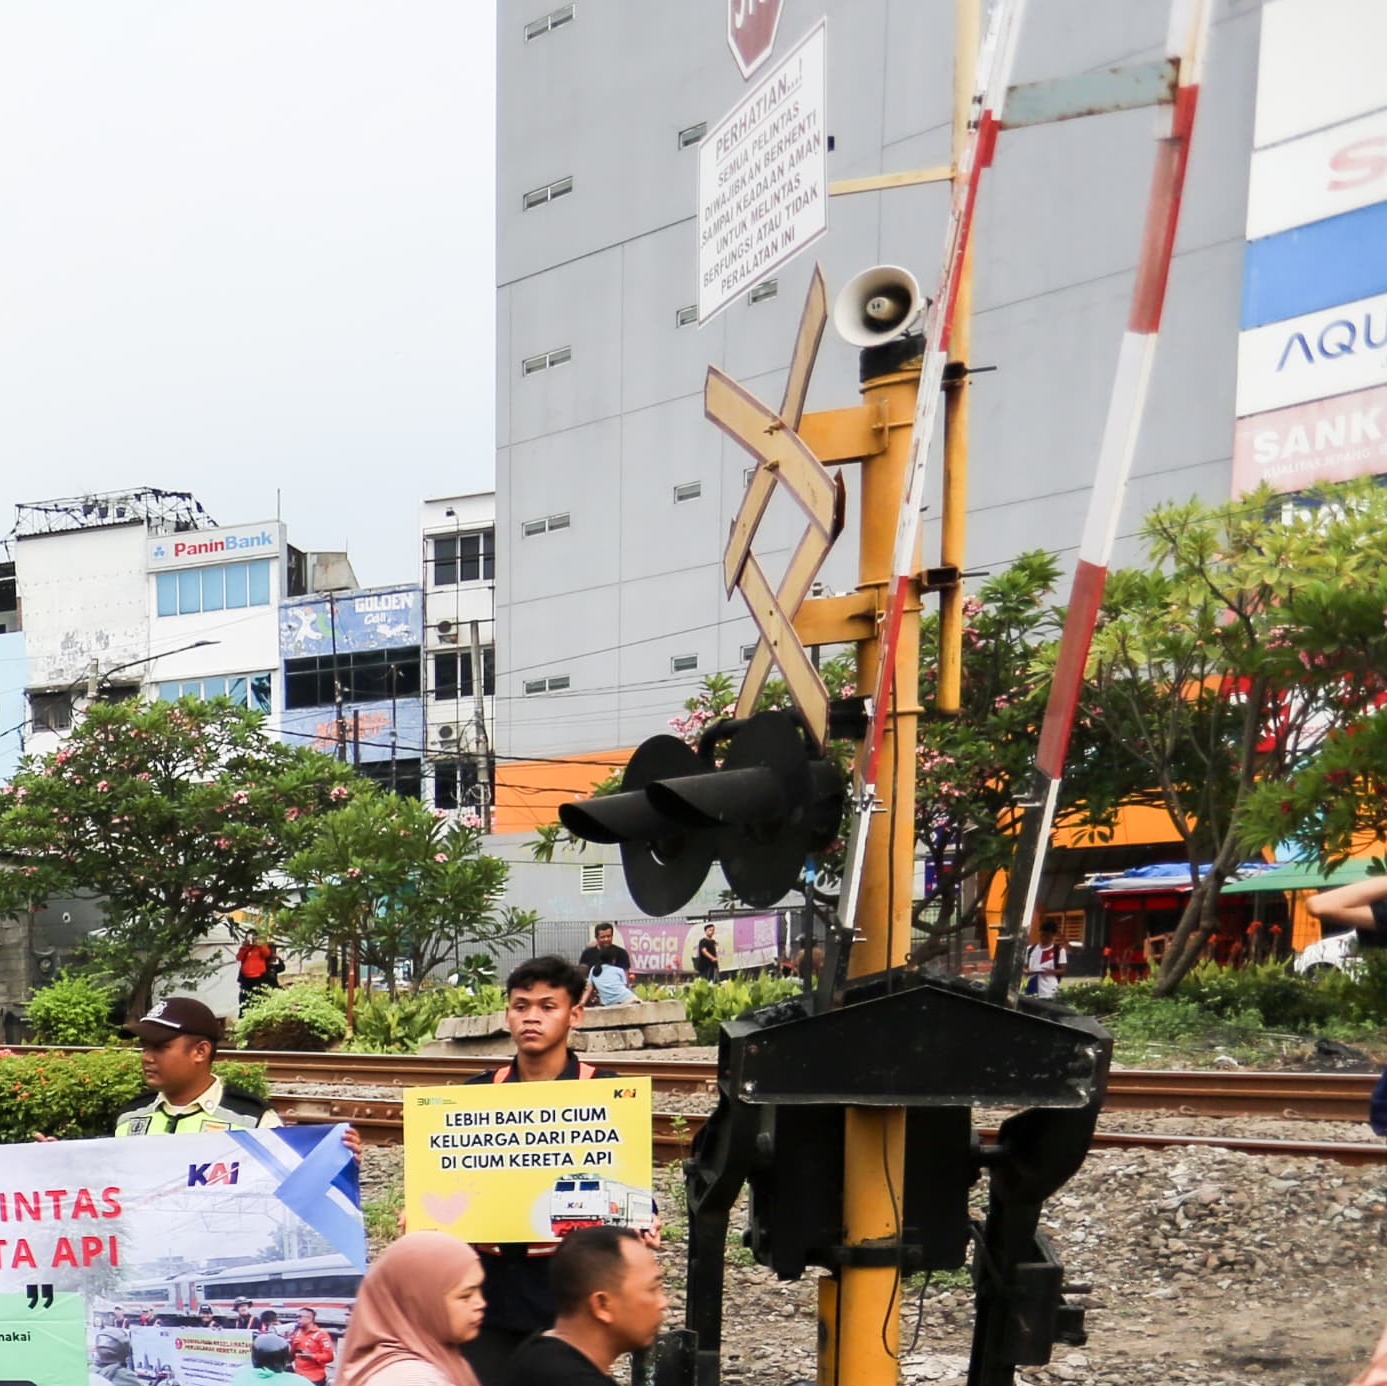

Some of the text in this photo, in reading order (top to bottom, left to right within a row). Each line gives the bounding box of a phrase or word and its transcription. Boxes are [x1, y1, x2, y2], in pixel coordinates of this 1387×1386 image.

[705, 109, 816, 222] DIWAJIBKAN BERHENTI
[718, 101, 799, 187] SEMUA PELINTAS
[702, 131, 821, 246] SAMPAI KEADAAN AMAN
[717, 173, 801, 255] UNTUK MELINTAS
[704, 183, 818, 287] BERFUNGSI ATAU TIDAK
[721, 225, 795, 294] PERALATAN INI
[174, 531, 273, 557] PaninBank
[354, 591, 414, 613] GOLDEN
[430, 1128, 619, 1149] KELUARGA DARI PADA
[445, 1107, 606, 1127] LEBIH BAIK DI CIUM
[441, 1151, 612, 1169] DI CIUM KERETA API
[51, 1235, 120, 1269] API
